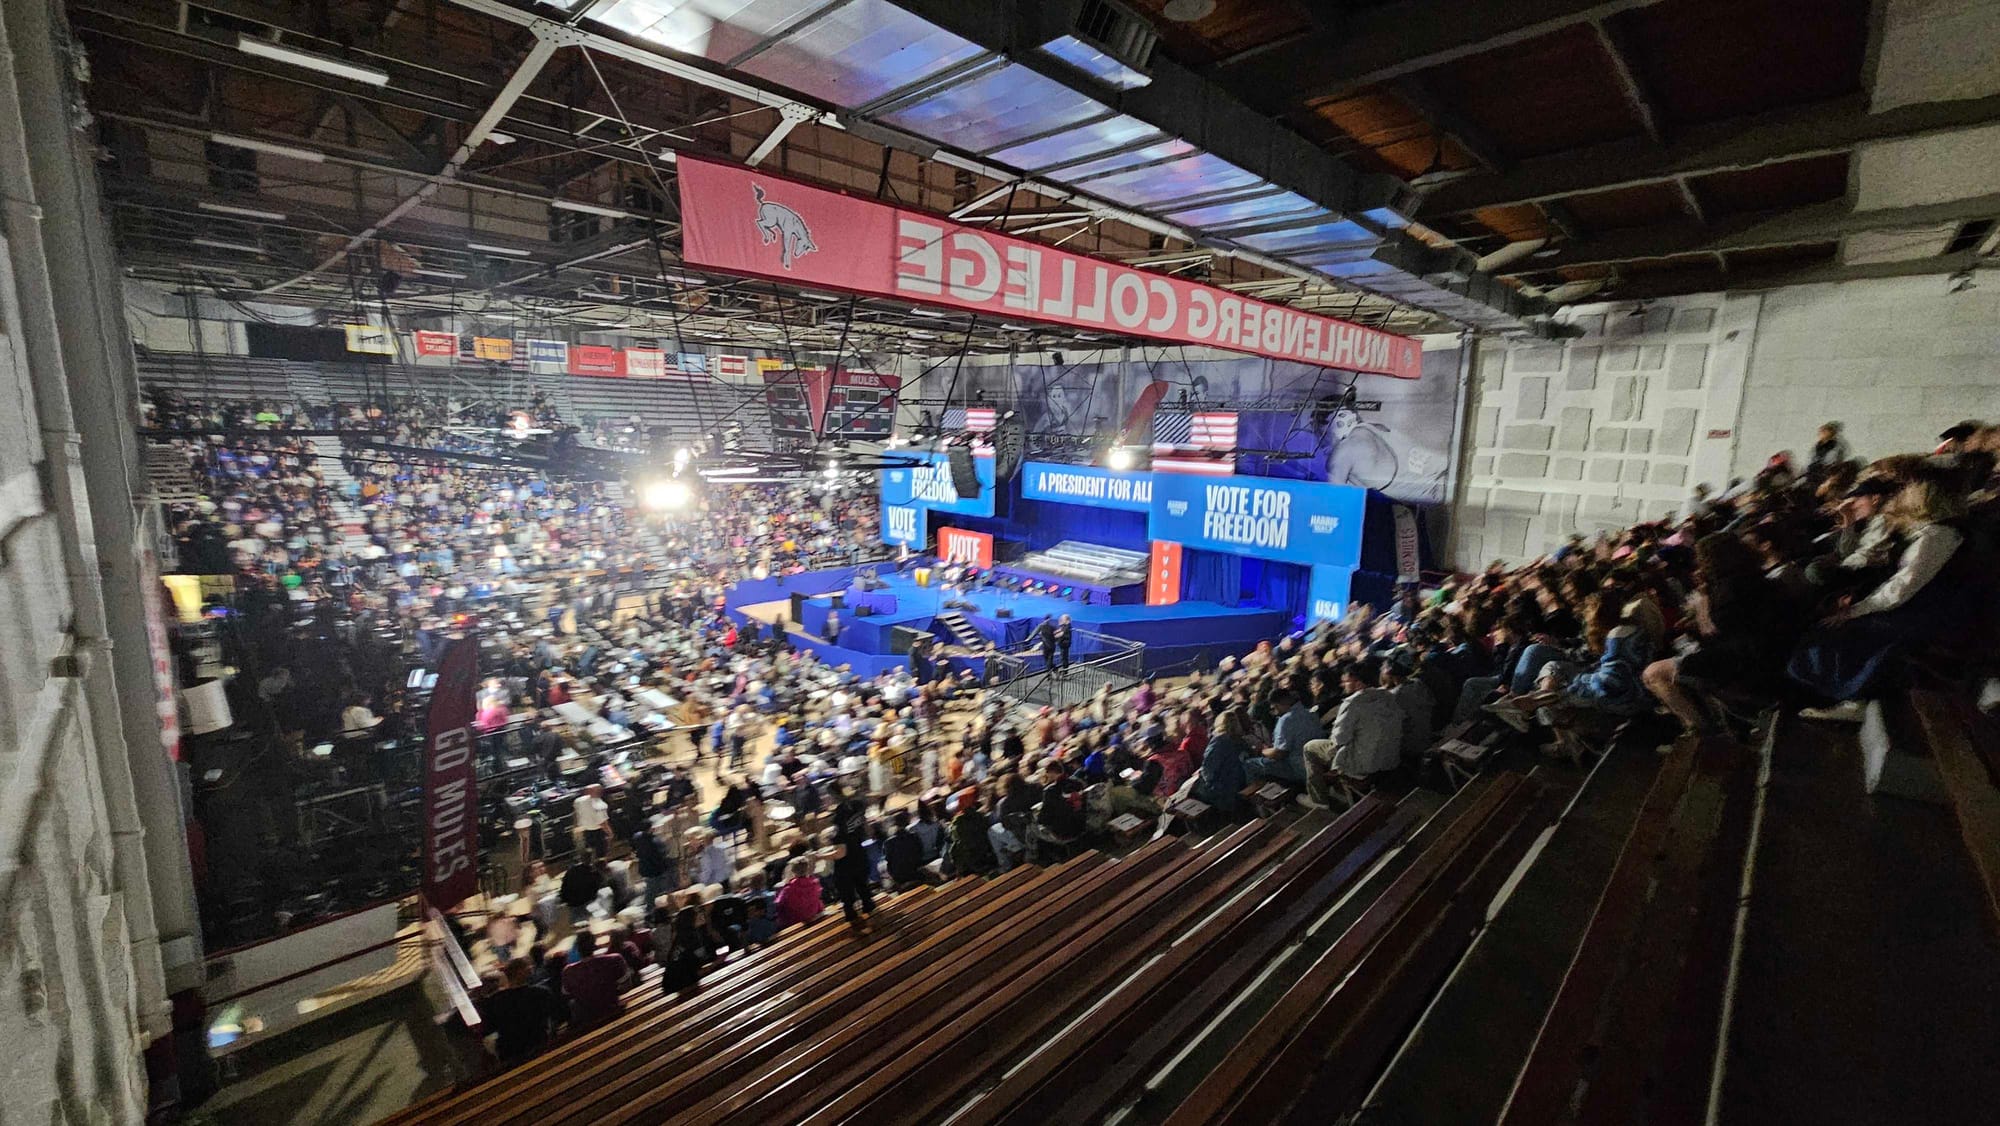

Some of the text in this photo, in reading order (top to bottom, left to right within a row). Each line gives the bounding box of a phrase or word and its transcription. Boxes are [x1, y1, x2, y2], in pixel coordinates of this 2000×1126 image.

[850, 375, 880, 386] MULES
[1039, 471, 1047, 492] A
[1048, 472, 1107, 499] PRESIDENT
[1108, 478, 1132, 501] FOR
[1206, 484, 1291, 520] VOTE FOR
[888, 505, 918, 532] VOTE
[1203, 511, 1288, 549] FREEDOM
[1315, 600, 1339, 619] USA
[433, 727, 470, 883] GO MULES
